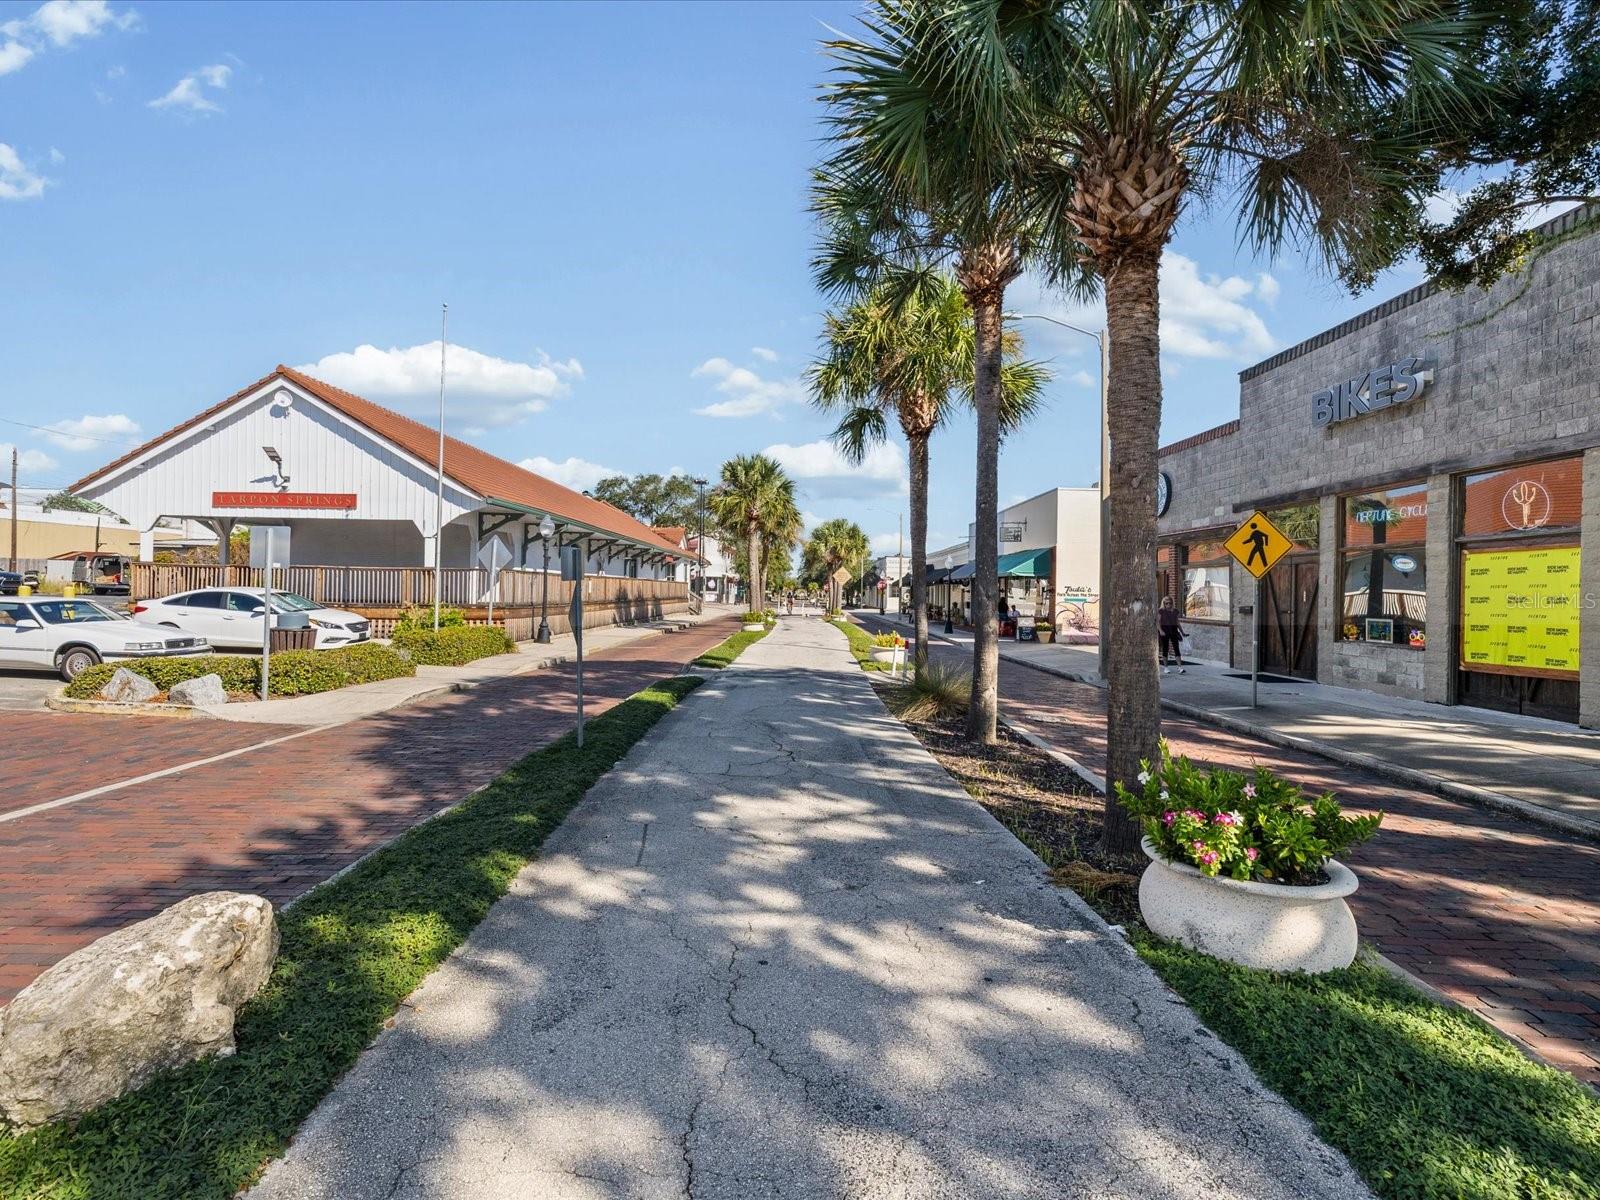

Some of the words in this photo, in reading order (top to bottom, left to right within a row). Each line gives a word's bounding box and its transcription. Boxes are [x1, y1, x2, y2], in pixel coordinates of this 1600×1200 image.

[1312, 357, 1420, 427] BIKES
[219, 495, 280, 504] TARPON
[287, 495, 353, 506] SPRINGS
